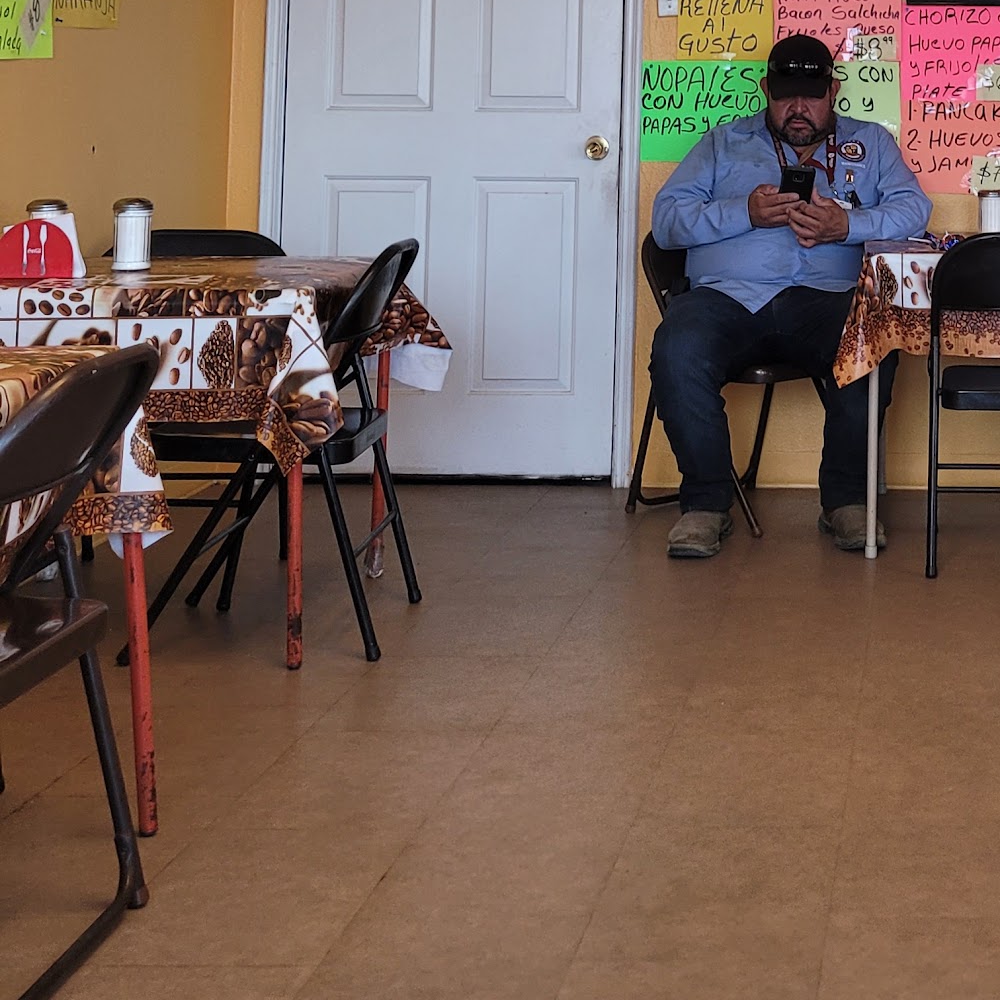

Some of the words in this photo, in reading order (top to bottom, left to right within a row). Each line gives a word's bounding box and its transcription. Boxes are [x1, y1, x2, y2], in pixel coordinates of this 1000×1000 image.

[778, 8, 822, 20] Bacon
[905, 7, 990, 25] CHORIZO
[679, 28, 758, 56] GUSTO
[642, 64, 759, 95] NOPALES
[859, 67, 894, 82] CON
[642, 93, 683, 111] CON
[643, 117, 696, 135] PAPAS
